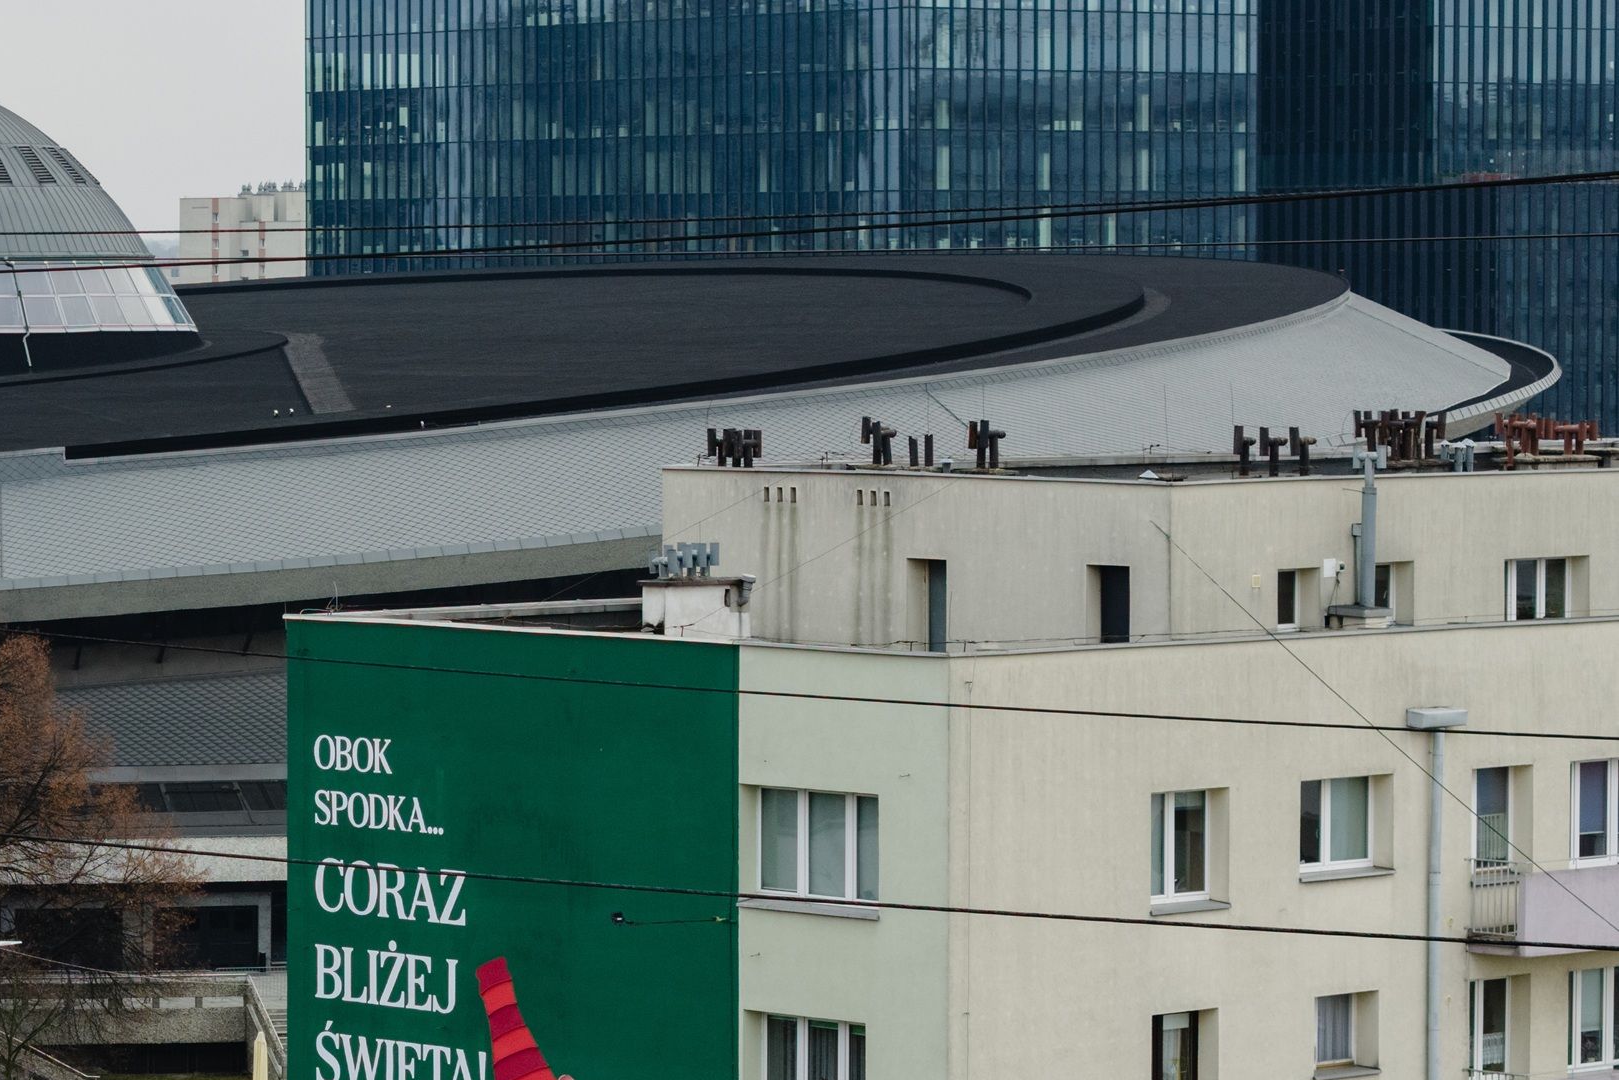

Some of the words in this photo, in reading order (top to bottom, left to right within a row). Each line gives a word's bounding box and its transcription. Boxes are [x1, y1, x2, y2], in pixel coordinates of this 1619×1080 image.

[313, 734, 393, 775] OBOK
[314, 789, 444, 835] SPODKA...
[314, 858, 466, 927] CORAZ
[314, 940, 459, 1014] BLIŻEJ
